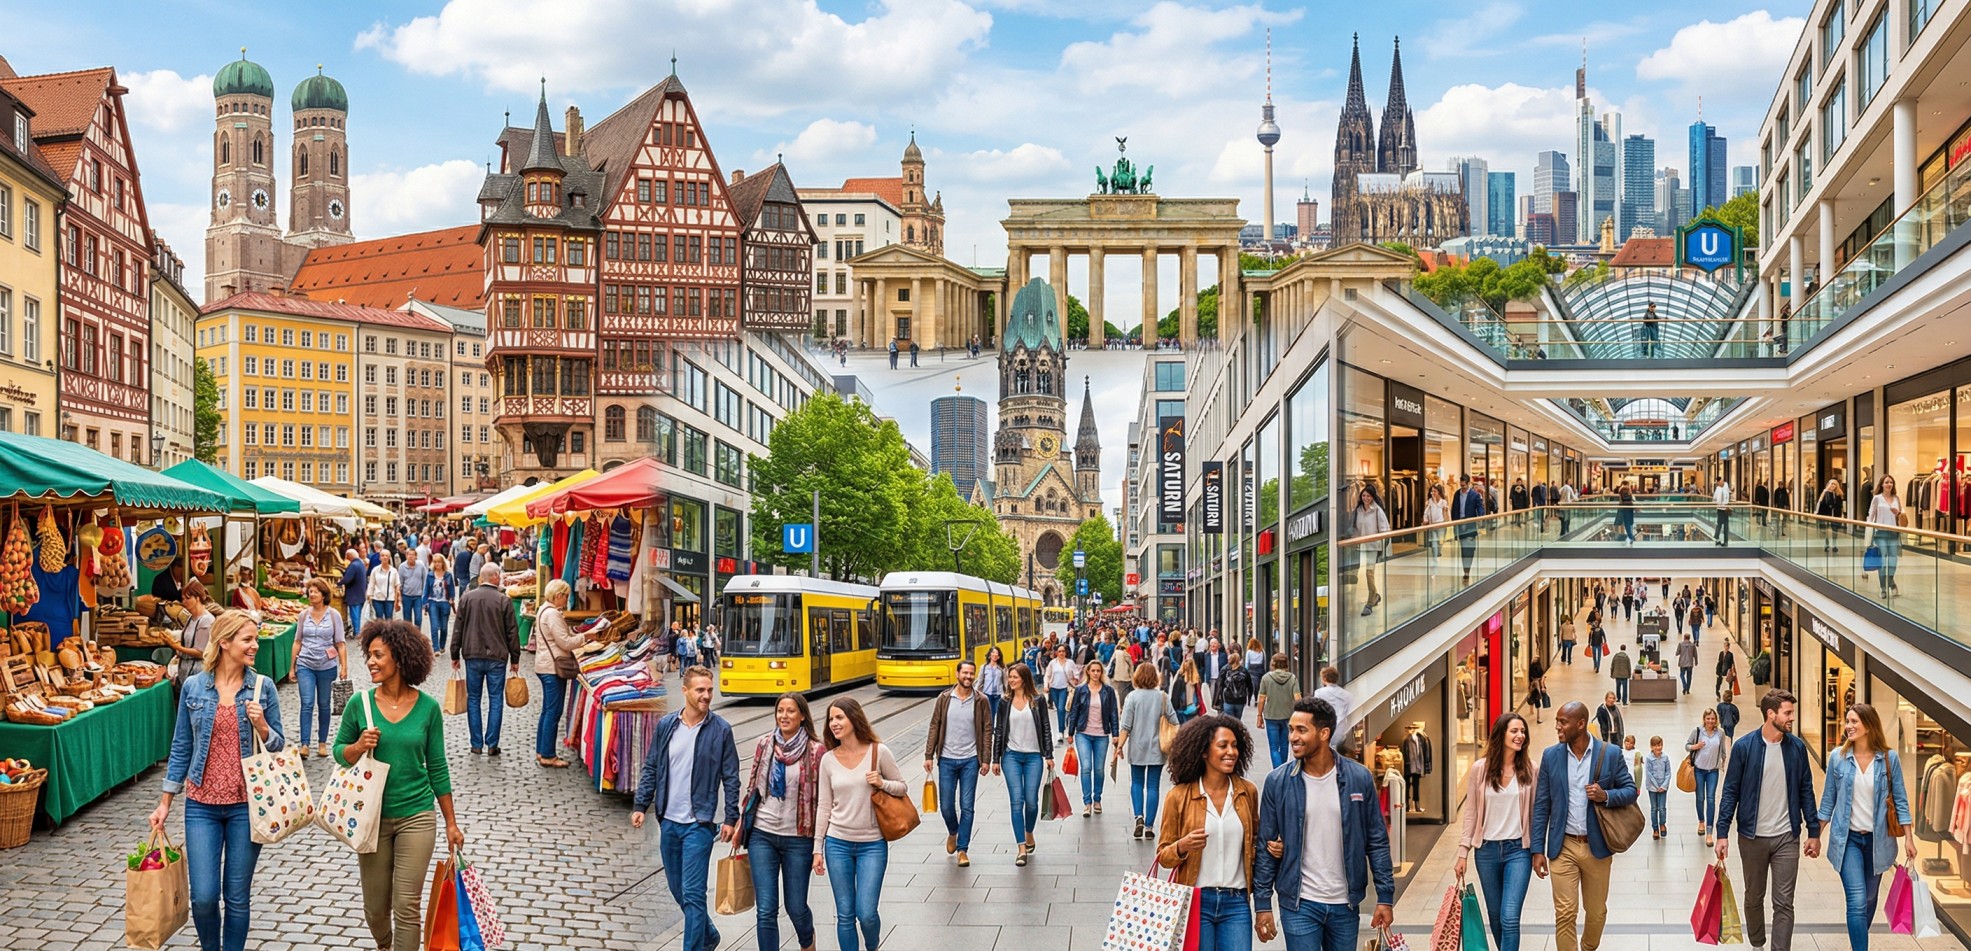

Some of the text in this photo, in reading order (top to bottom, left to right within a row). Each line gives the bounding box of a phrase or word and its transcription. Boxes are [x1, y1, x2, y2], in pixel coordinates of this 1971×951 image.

[1701, 232, 1718, 256] U
[1164, 452, 1181, 512] SATURN
[1206, 485, 1219, 527] SATURN
[790, 528, 805, 548] U
